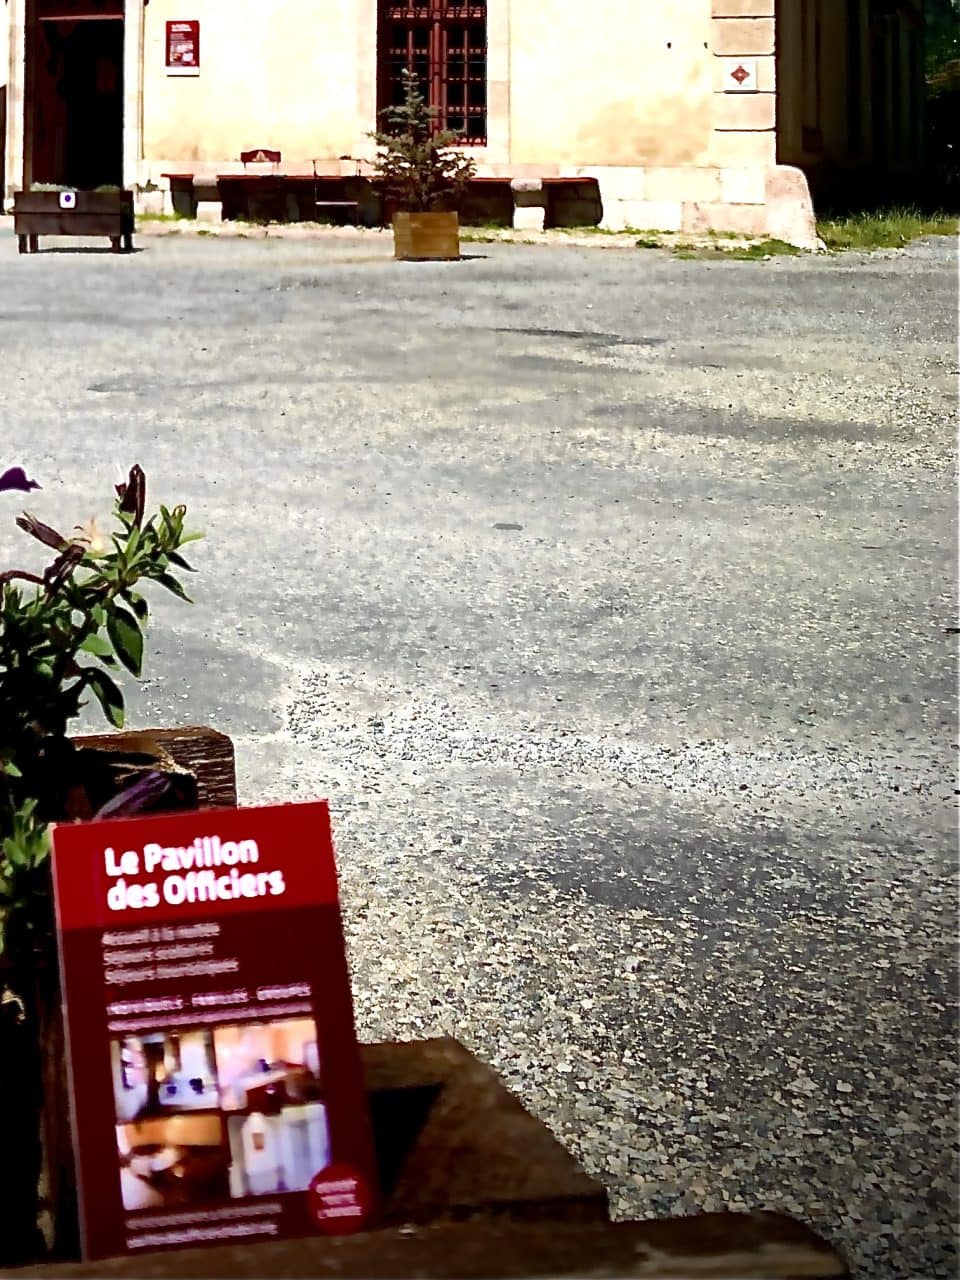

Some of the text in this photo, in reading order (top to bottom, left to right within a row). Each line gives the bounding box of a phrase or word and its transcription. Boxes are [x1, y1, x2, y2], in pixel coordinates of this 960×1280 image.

[104, 835, 259, 876] Le Pavillon
[107, 867, 286, 910] des Officiers
